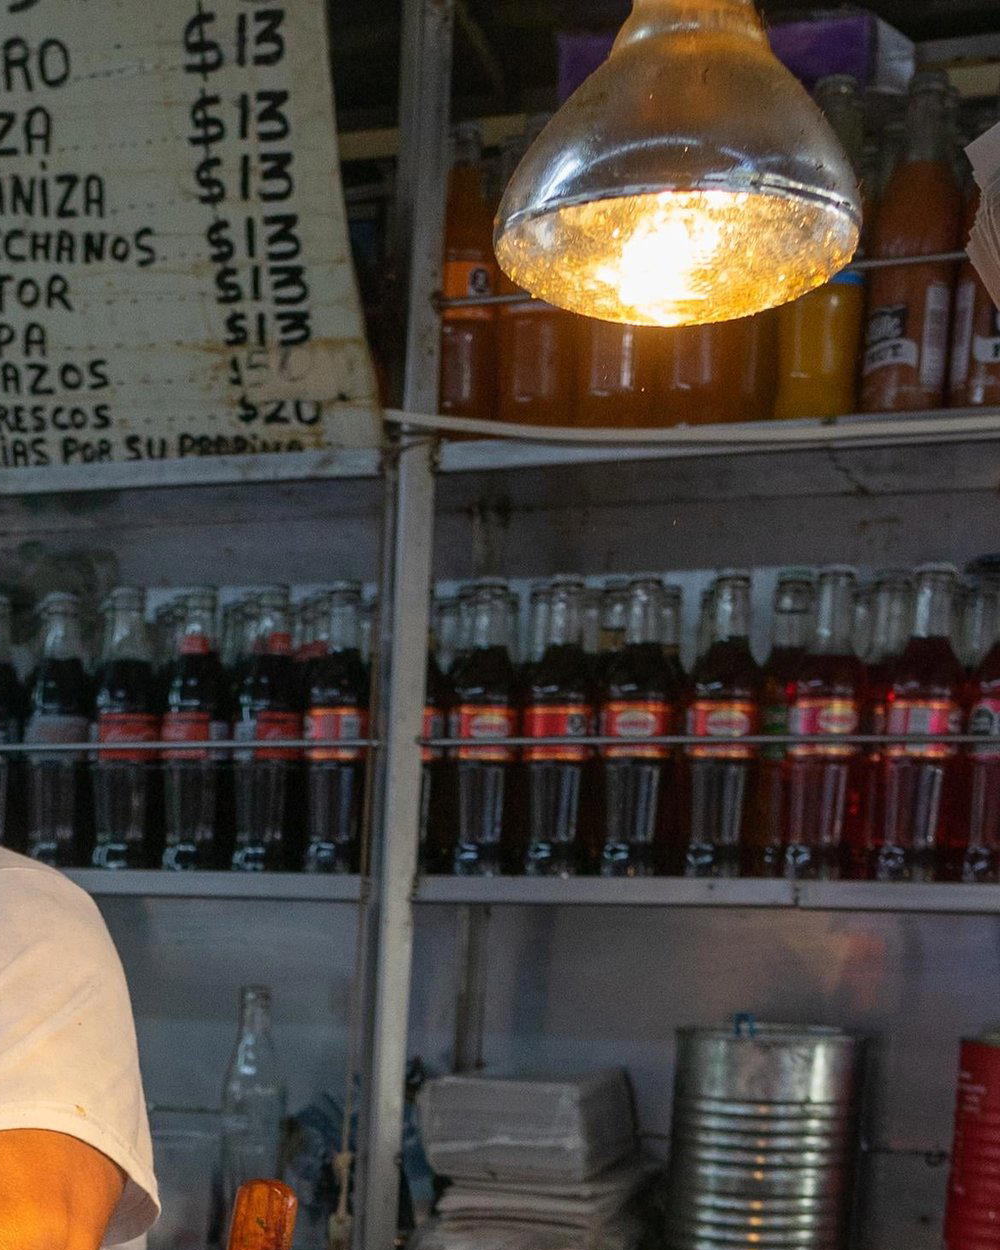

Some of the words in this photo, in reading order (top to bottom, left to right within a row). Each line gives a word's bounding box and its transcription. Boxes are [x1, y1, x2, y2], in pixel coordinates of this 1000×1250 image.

[183, 2, 285, 82] $13
[188, 88, 290, 156] $13
[196, 153, 294, 206] $13
[206, 214, 301, 264] $13
[215, 265, 310, 305] $13
[224, 311, 312, 346] $13
[238, 396, 322, 425] $20
[125, 433, 167, 462] SU
